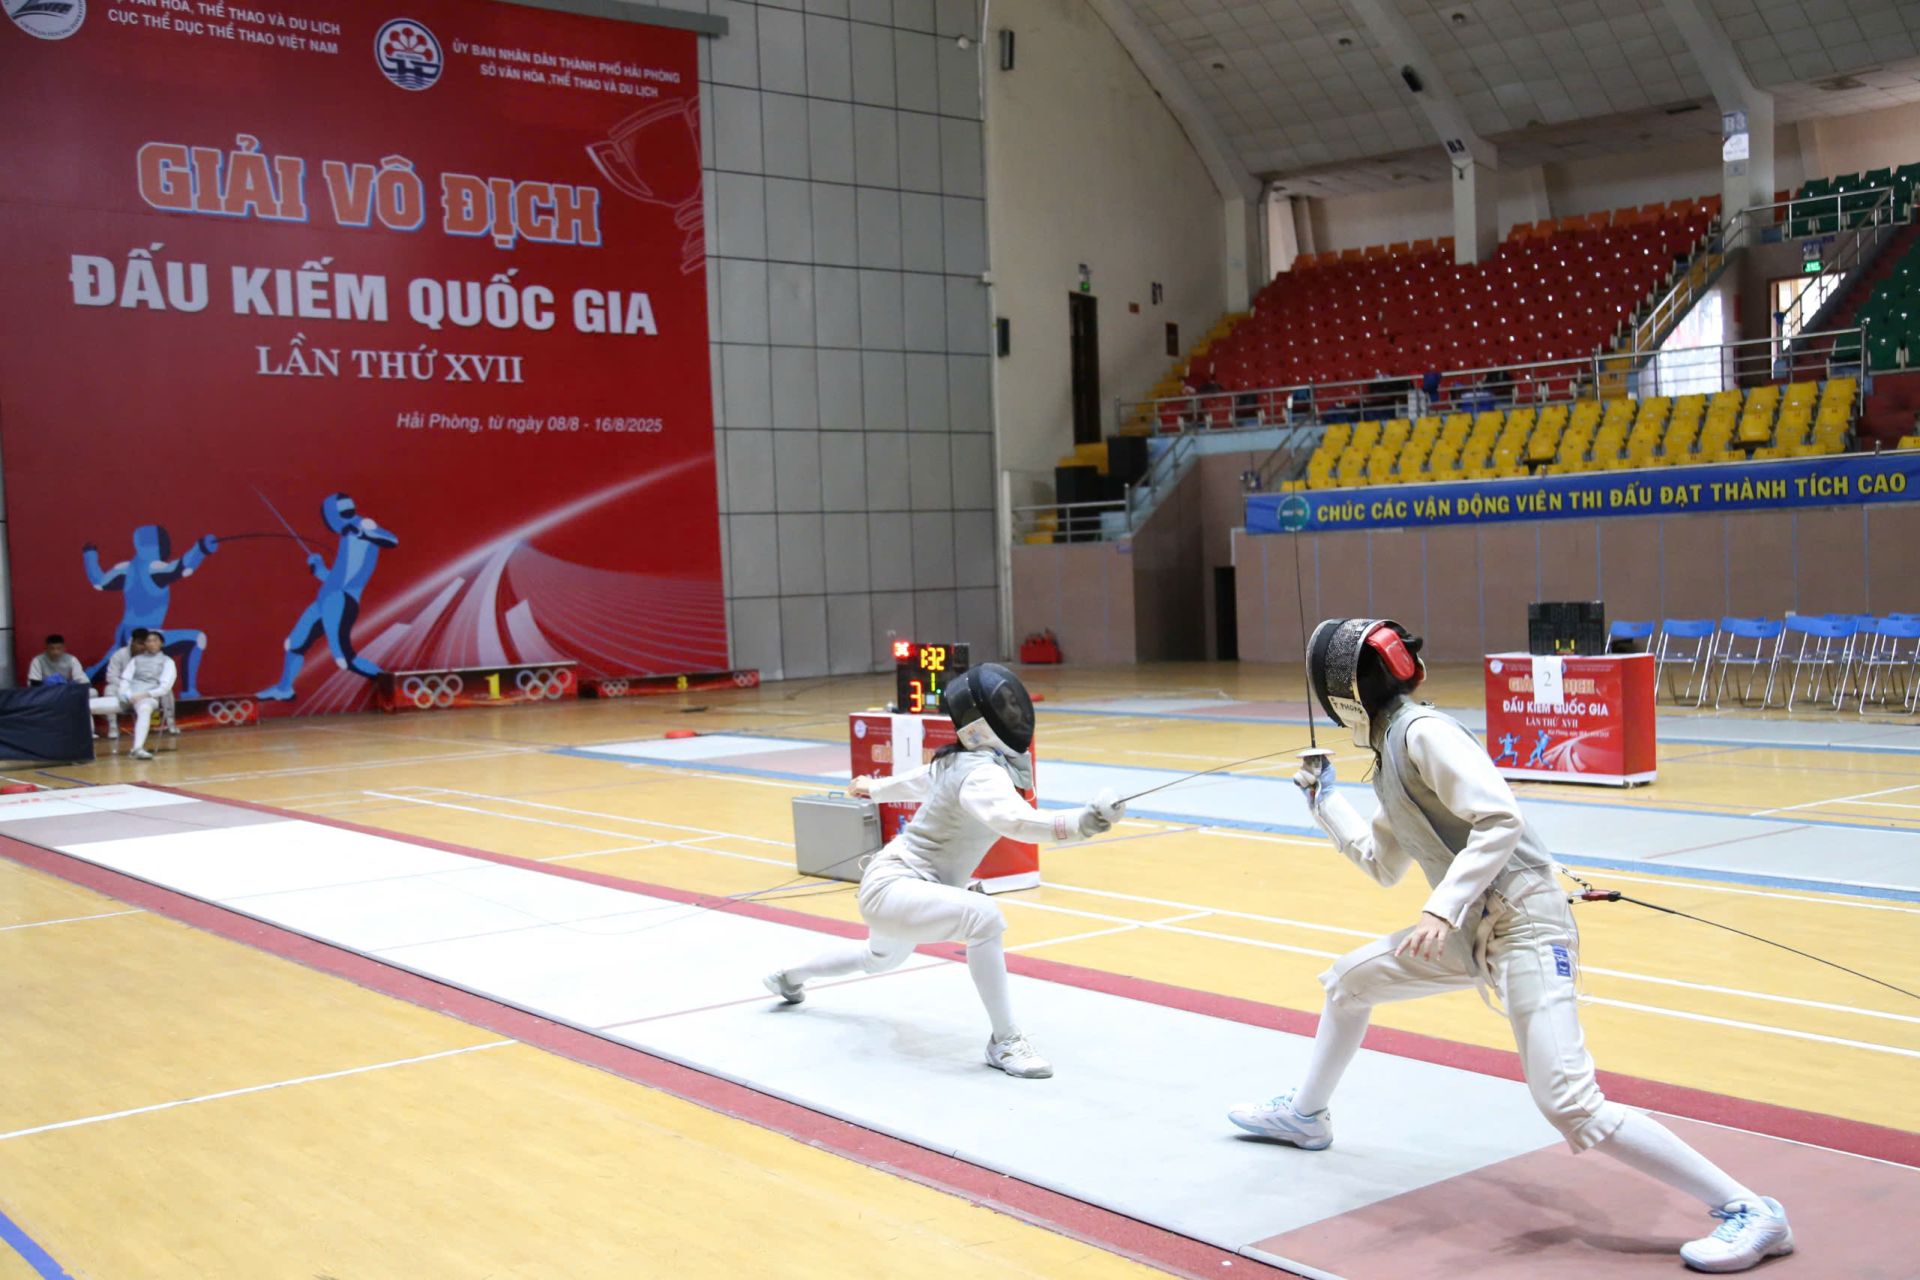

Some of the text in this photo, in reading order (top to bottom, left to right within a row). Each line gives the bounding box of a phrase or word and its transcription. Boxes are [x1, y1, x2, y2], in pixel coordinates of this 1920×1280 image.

[108, 9, 138, 25] CỤC
[142, 11, 171, 30] THỂ
[175, 19, 204, 36] DỤC
[238, 28, 275, 46] THAO
[277, 34, 306, 50] VIỆT
[310, 39, 338, 54] NAM
[228, 7, 265, 24] THAO
[267, 12, 285, 27] VÀ
[288, 17, 307, 31] DU
[472, 44, 496, 58] BAN
[574, 76, 601, 91] THAO
[619, 82, 634, 95] DU
[137, 133, 602, 249] GIẢI VÔ ĐỊCH
[69, 242, 658, 335] ĐẤU KIẾM QUỐC GIA
[255, 332, 525, 383] LẦN THỨ XVII
[396, 411, 425, 429] Hải
[428, 412, 483, 433] Phòng,
[487, 413, 503, 430] từ
[507, 415, 544, 434] ngày
[547, 416, 580, 432] 08/8
[595, 416, 663, 433] 16/8/2025
[1317, 472, 1906, 522] CHÚC CÁC VẬN ĐỘNG VIÊN THI ĐẤU ĐẠT THÀNH TÍCH CAO
[484, 672, 500, 700] 1
[1543, 671, 1552, 687] 2
[910, 681, 922, 712] 3
[1503, 696, 1524, 713] ĐẤU
[1589, 703, 1609, 716] GIA
